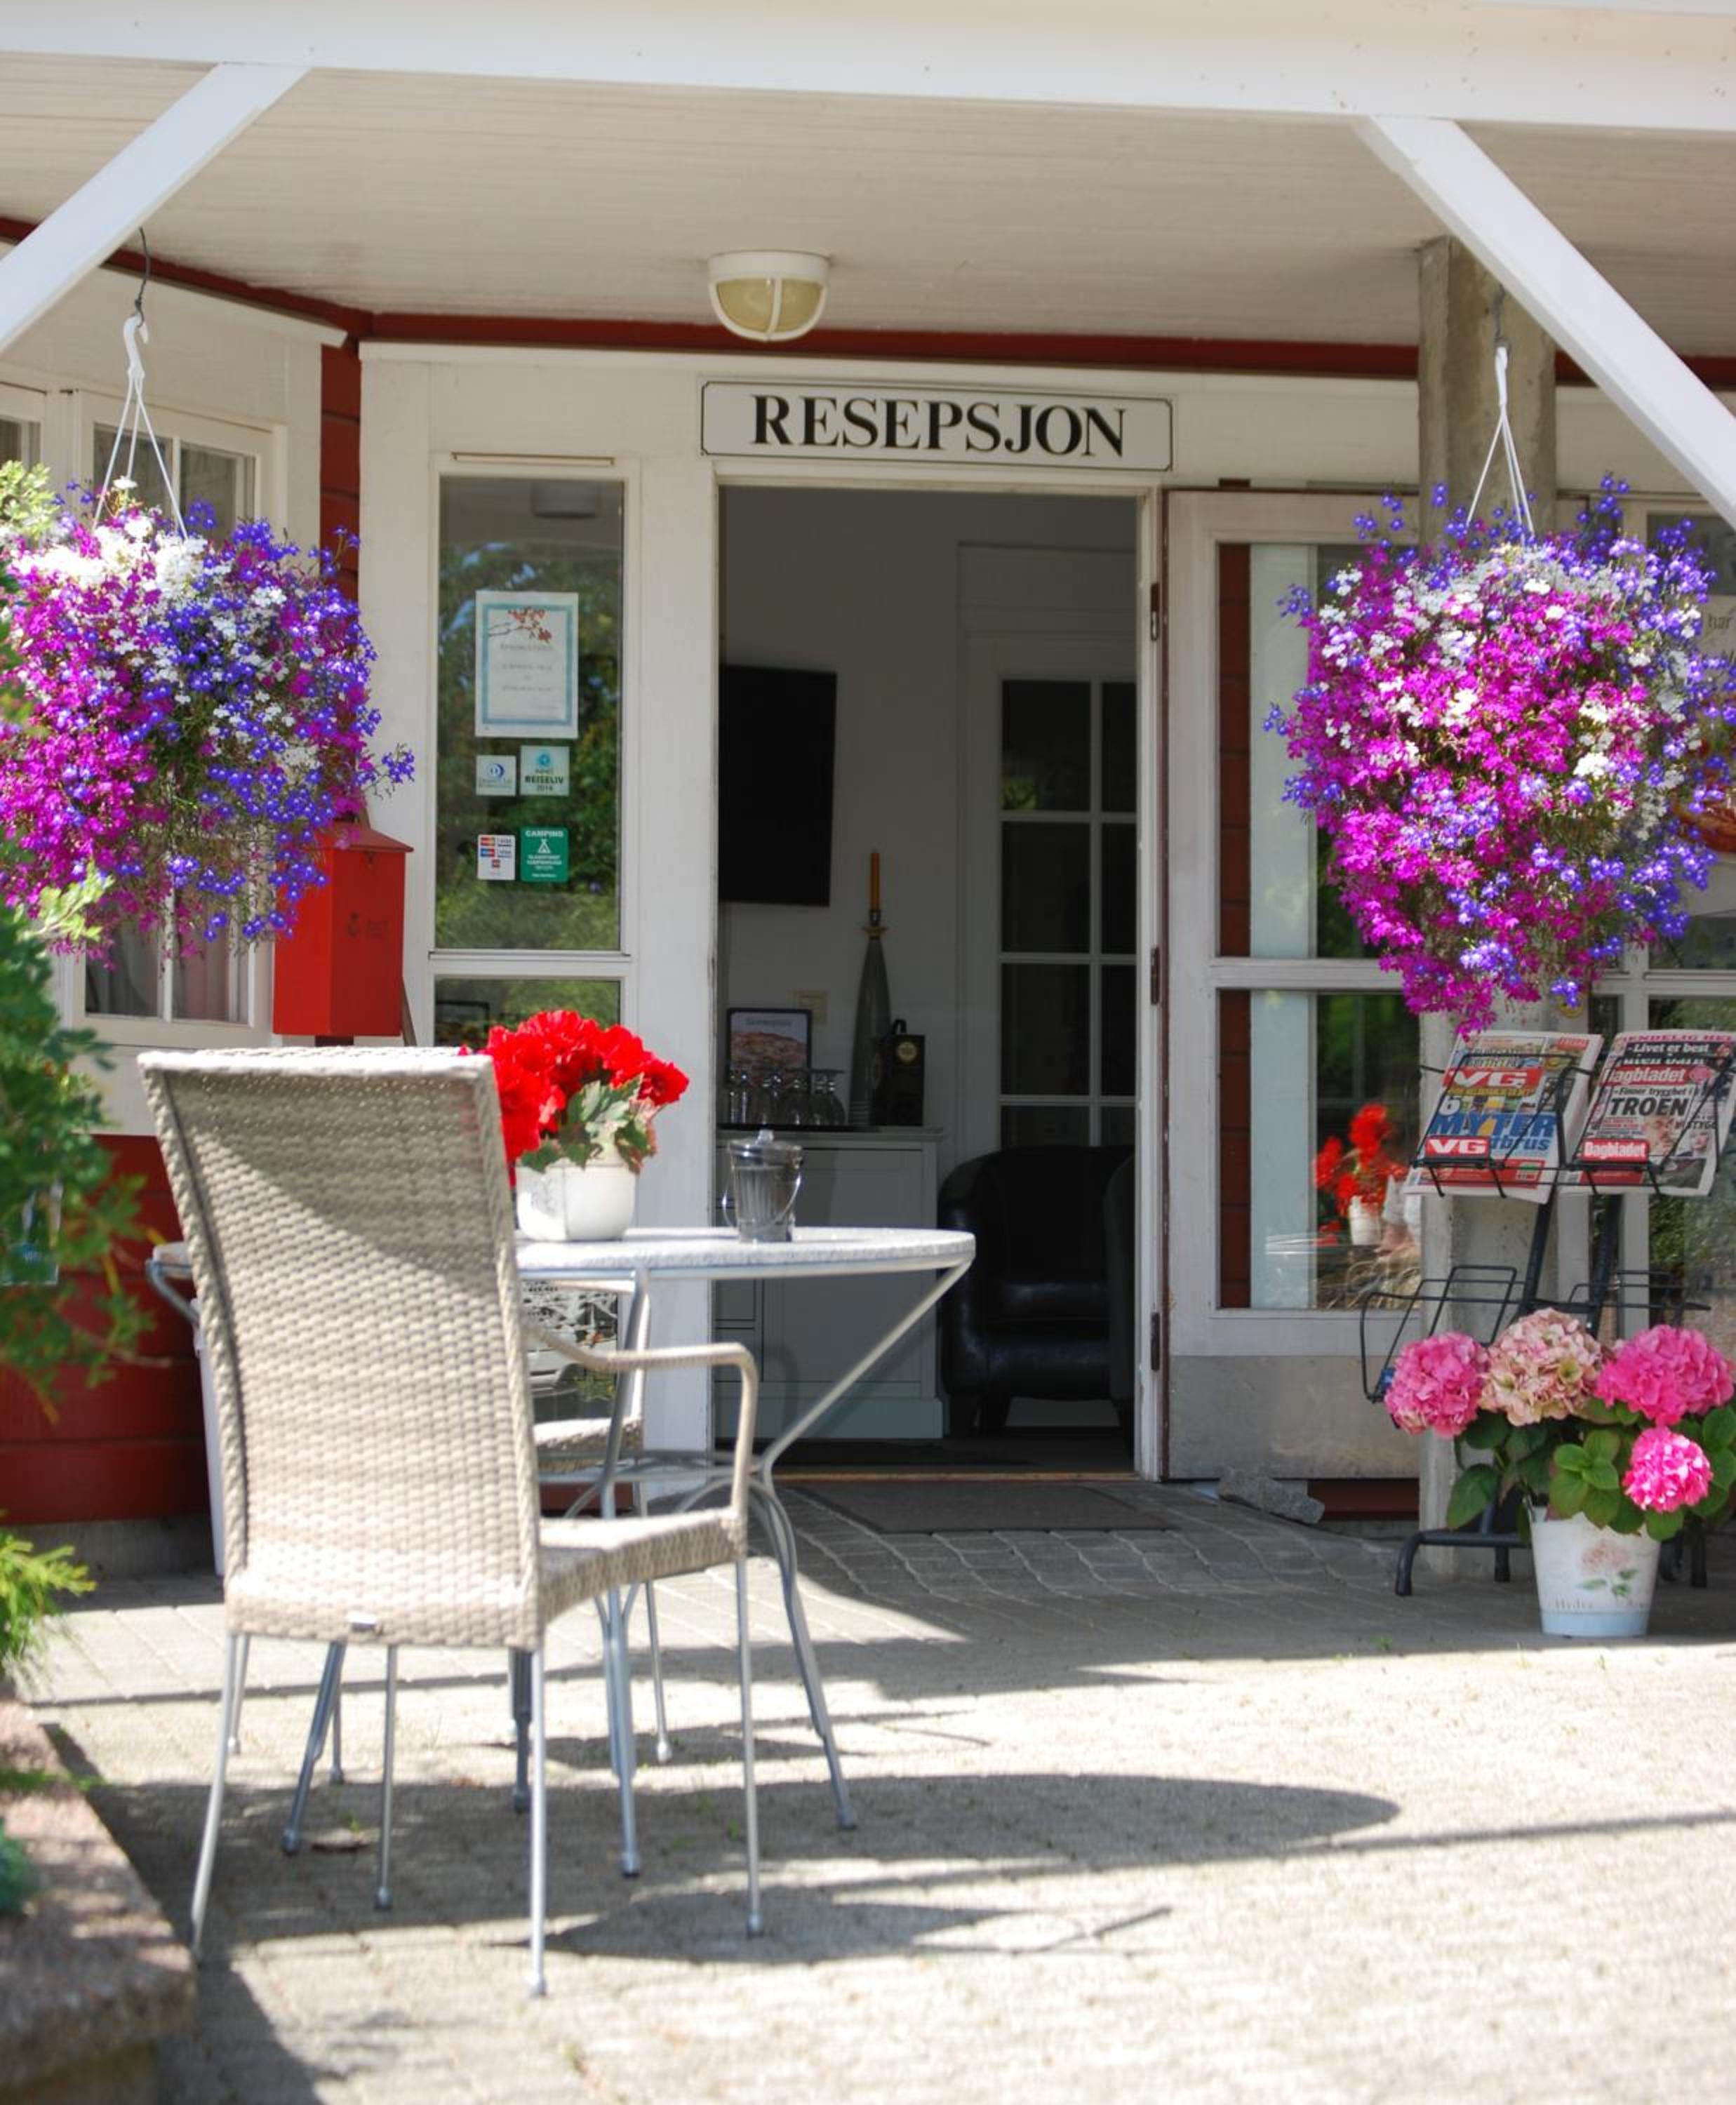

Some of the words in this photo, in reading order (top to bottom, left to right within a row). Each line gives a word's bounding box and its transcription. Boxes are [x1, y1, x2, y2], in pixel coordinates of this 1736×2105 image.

[751, 394, 1127, 457] RESEPSJON
[1667, 1044, 1680, 1052] er
[1683, 1043, 1709, 1052] best
[1453, 1071, 1528, 1088] VG
[1610, 1097, 1689, 1116] TROEN
[1429, 1113, 1556, 1137] MYTER
[1429, 1139, 1486, 1154] VG
[1584, 1141, 1646, 1159] Dagbladet
